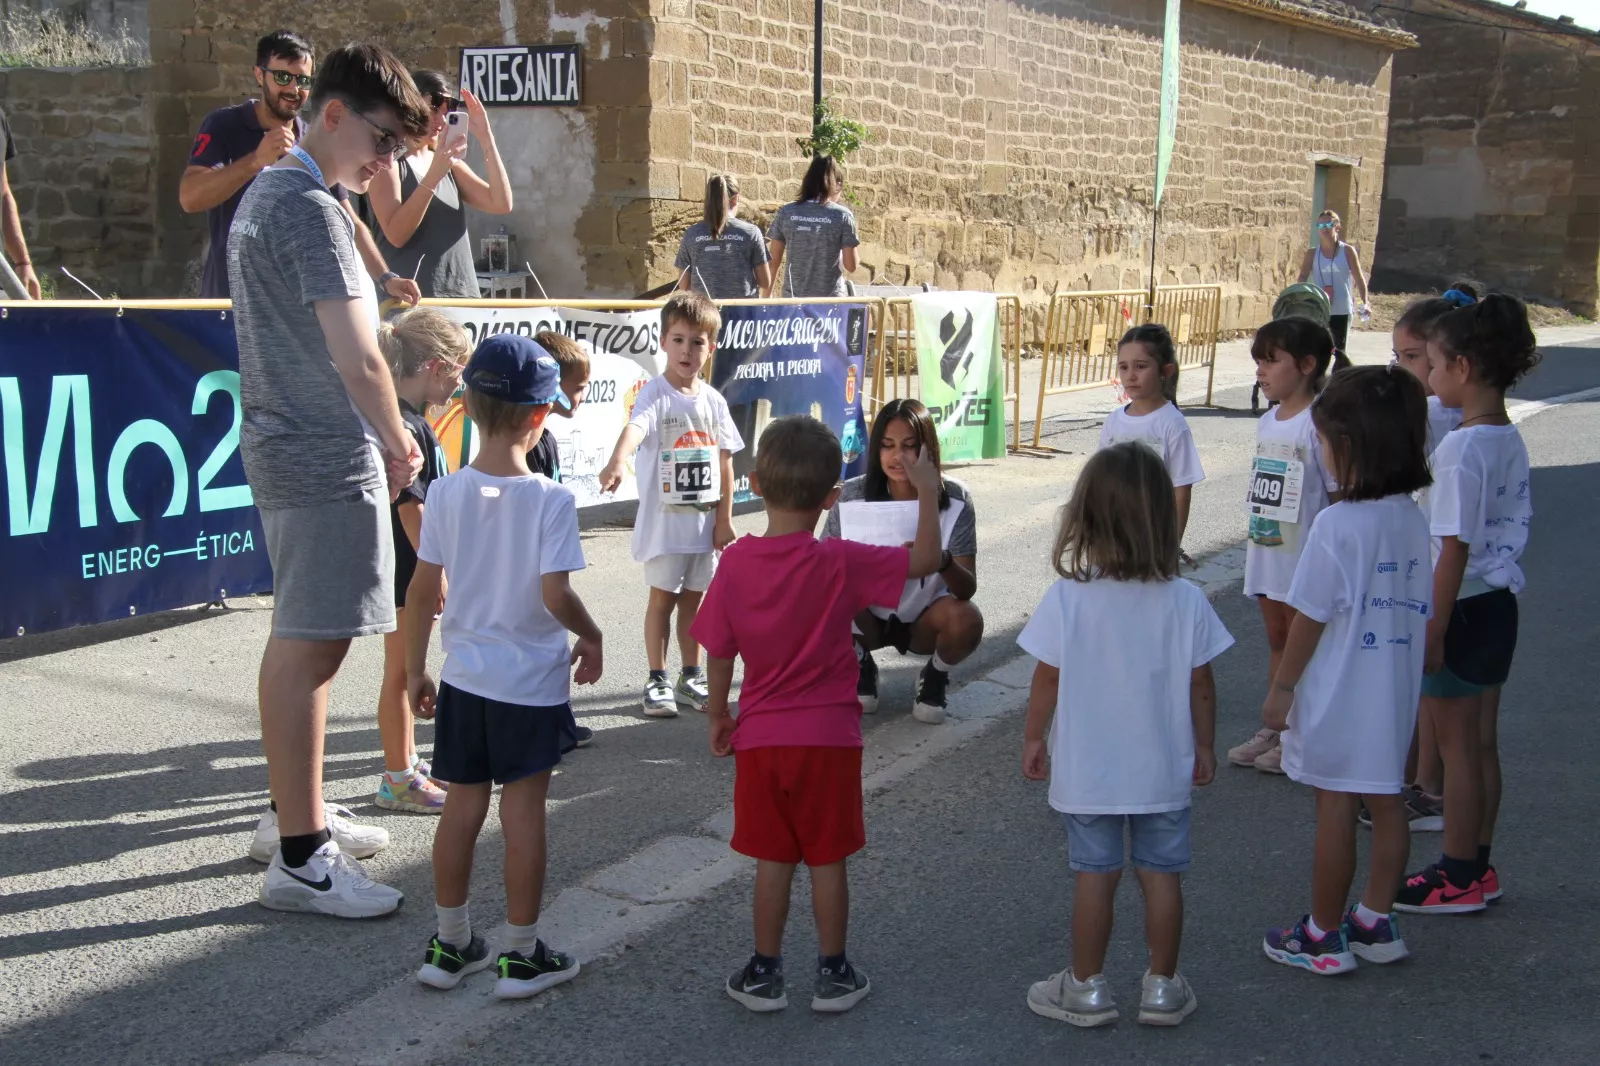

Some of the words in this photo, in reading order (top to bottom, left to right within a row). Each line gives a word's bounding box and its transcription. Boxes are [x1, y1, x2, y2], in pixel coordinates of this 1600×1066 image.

[460, 47, 579, 102] ARTESANIA
[695, 233, 744, 243] ORGAIZACIÓN
[585, 379, 616, 404] 2023
[677, 466, 712, 488] 412
[1253, 477, 1282, 501] 409
